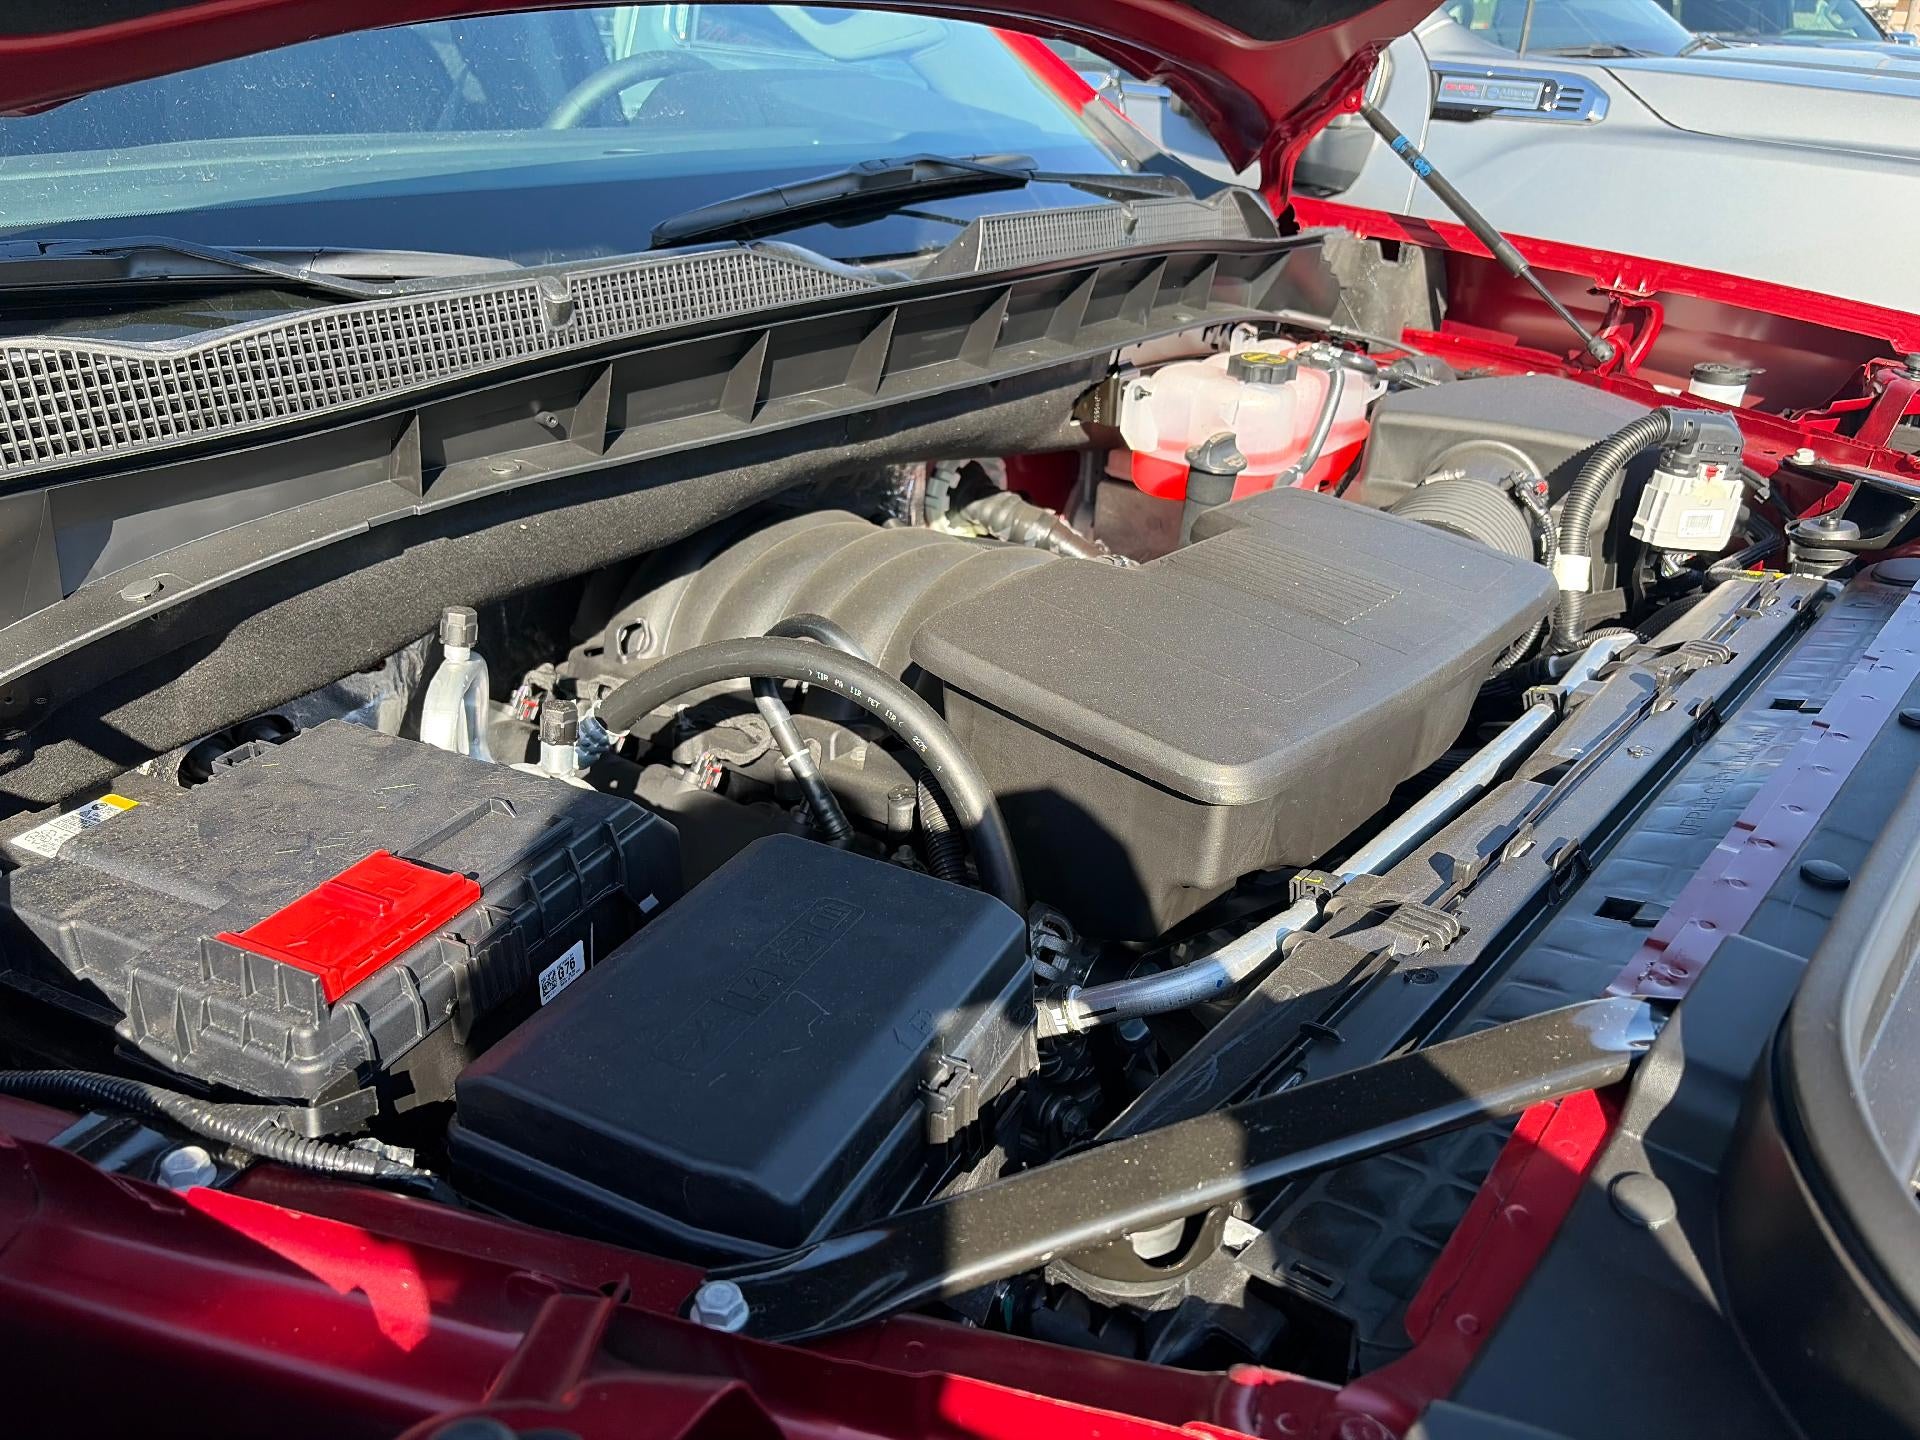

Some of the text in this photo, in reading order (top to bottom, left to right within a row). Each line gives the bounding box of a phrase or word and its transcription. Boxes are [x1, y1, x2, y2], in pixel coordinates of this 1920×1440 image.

[834, 678, 844, 689] PA
[850, 686, 862, 698] IIR
[867, 697, 880, 708] PET
[885, 709, 897, 722] IIR
[557, 956, 576, 980] G76
